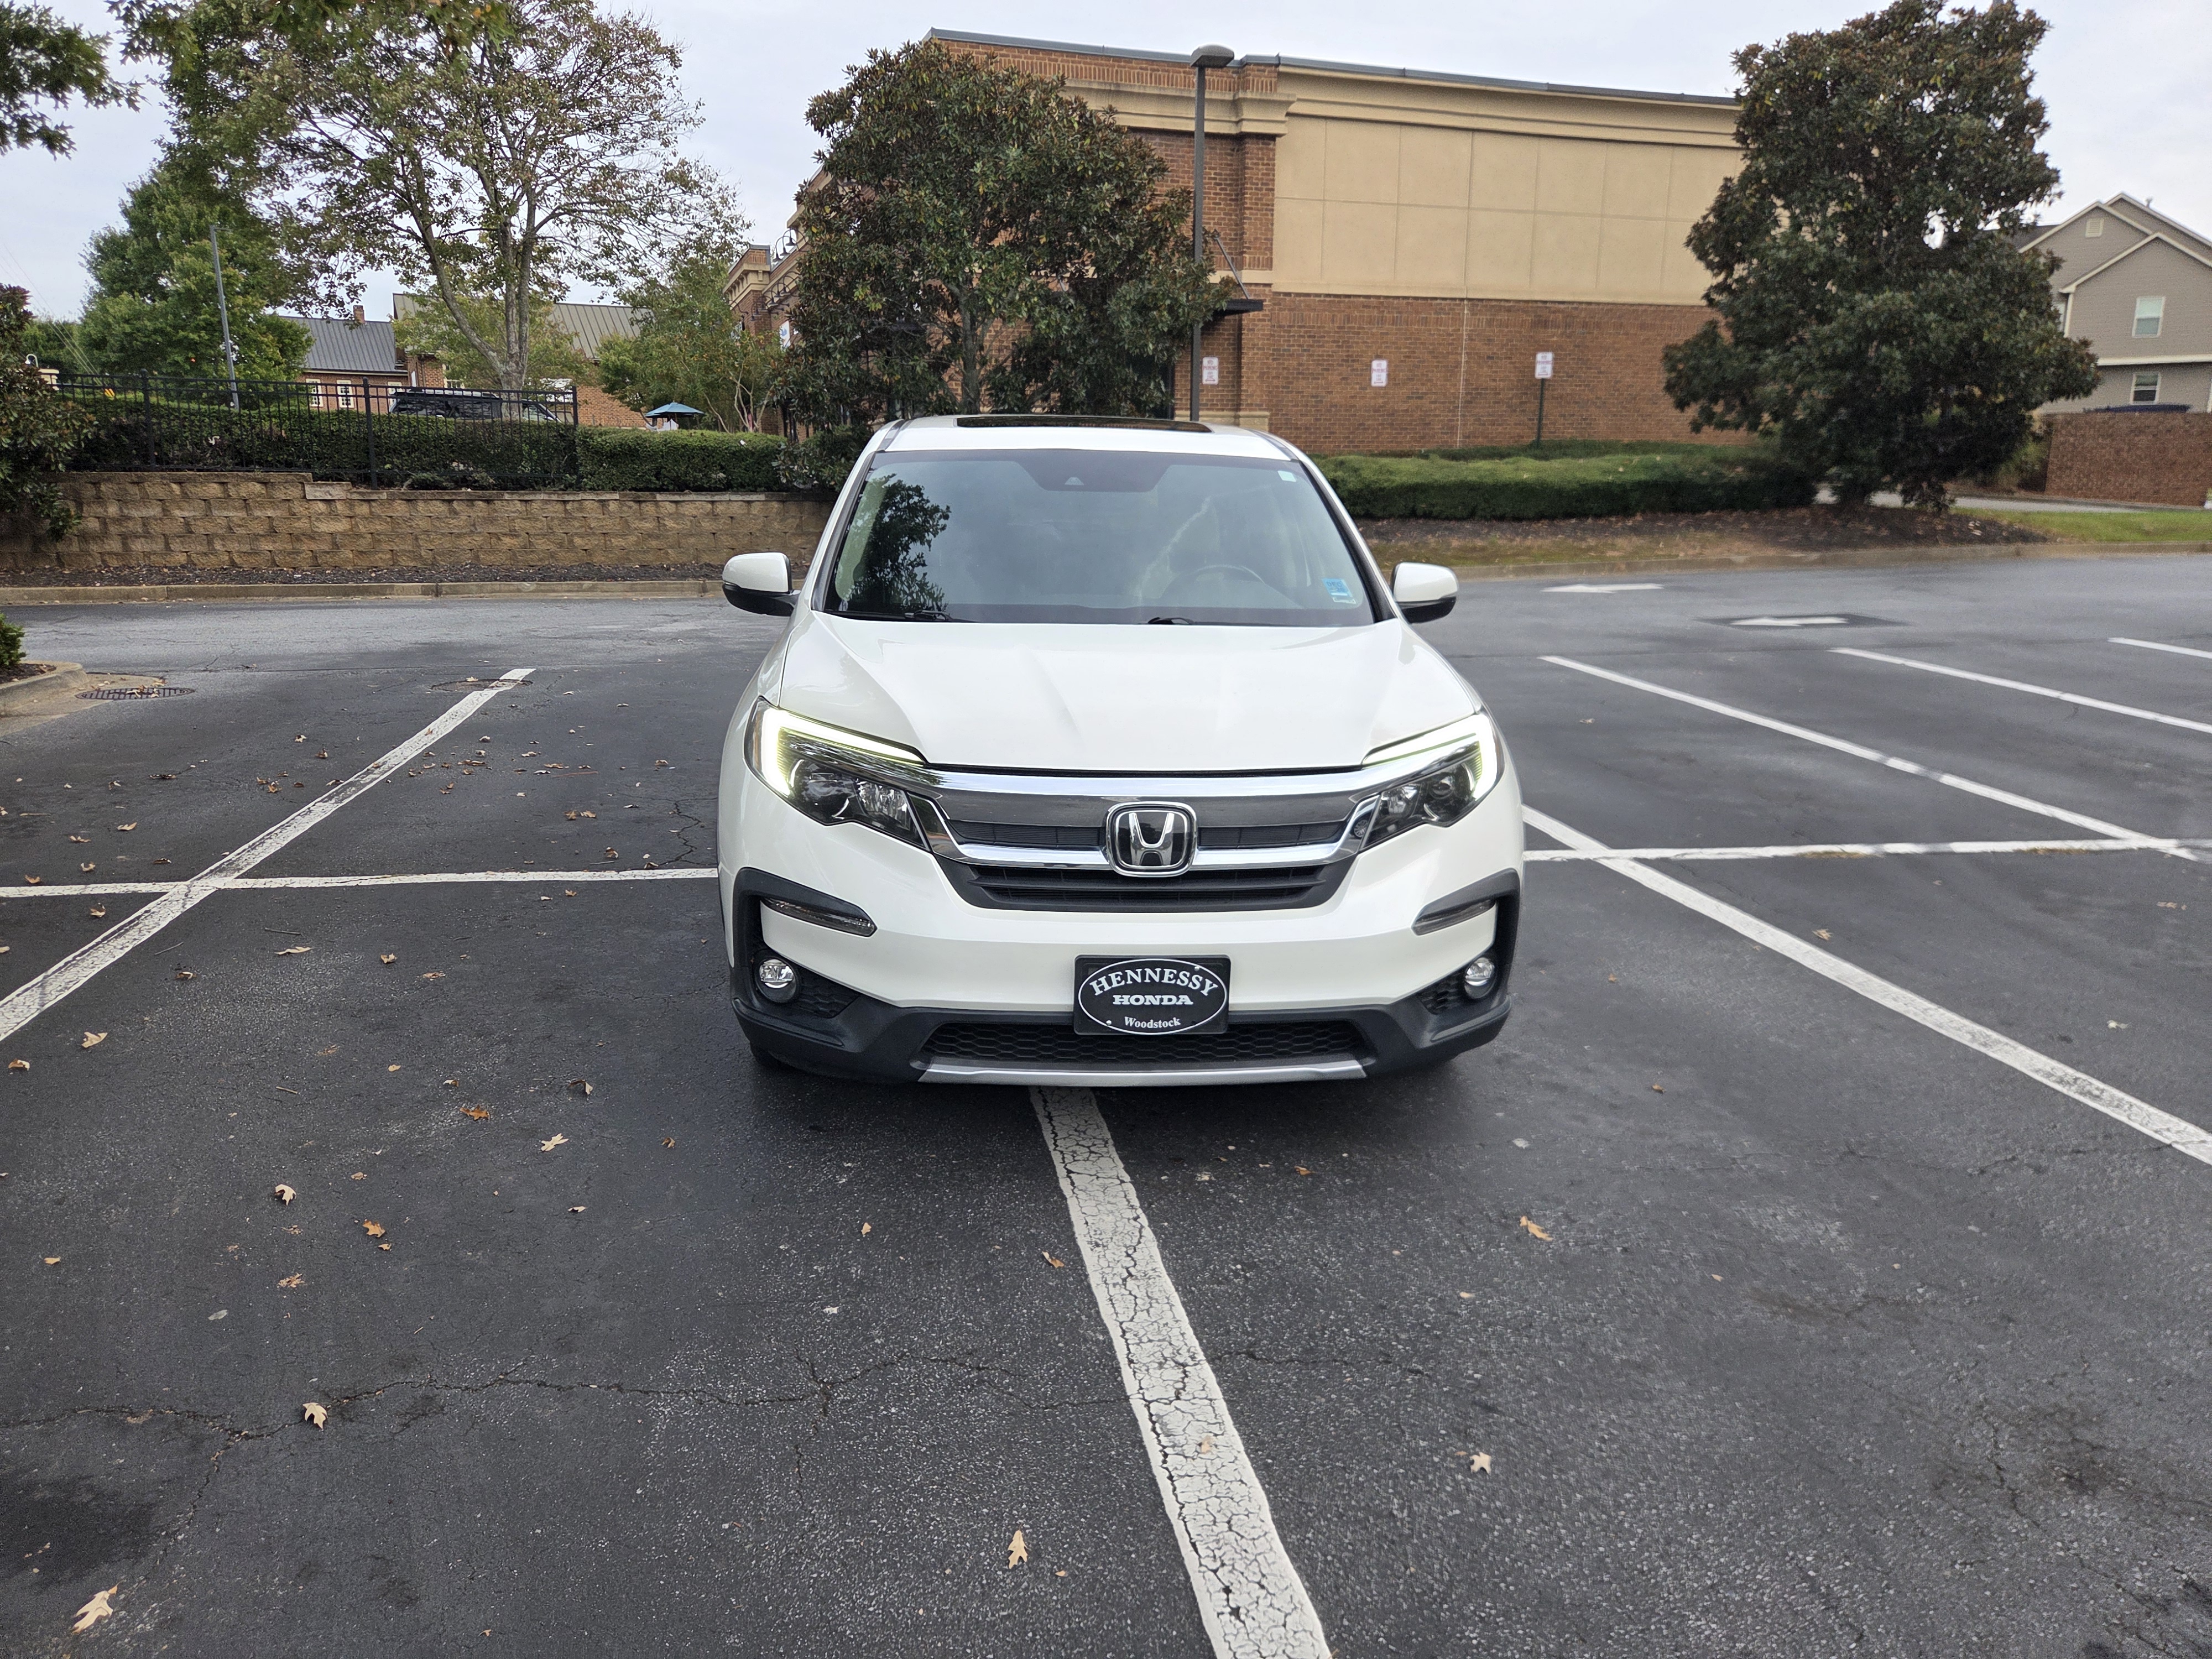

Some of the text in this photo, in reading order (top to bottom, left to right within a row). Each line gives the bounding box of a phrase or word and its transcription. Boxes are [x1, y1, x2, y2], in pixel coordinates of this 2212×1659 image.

[1089, 968, 1219, 996] HENNESSY
[1113, 995, 1193, 1005] HONDA
[1124, 1016, 1181, 1029] Woodstock
